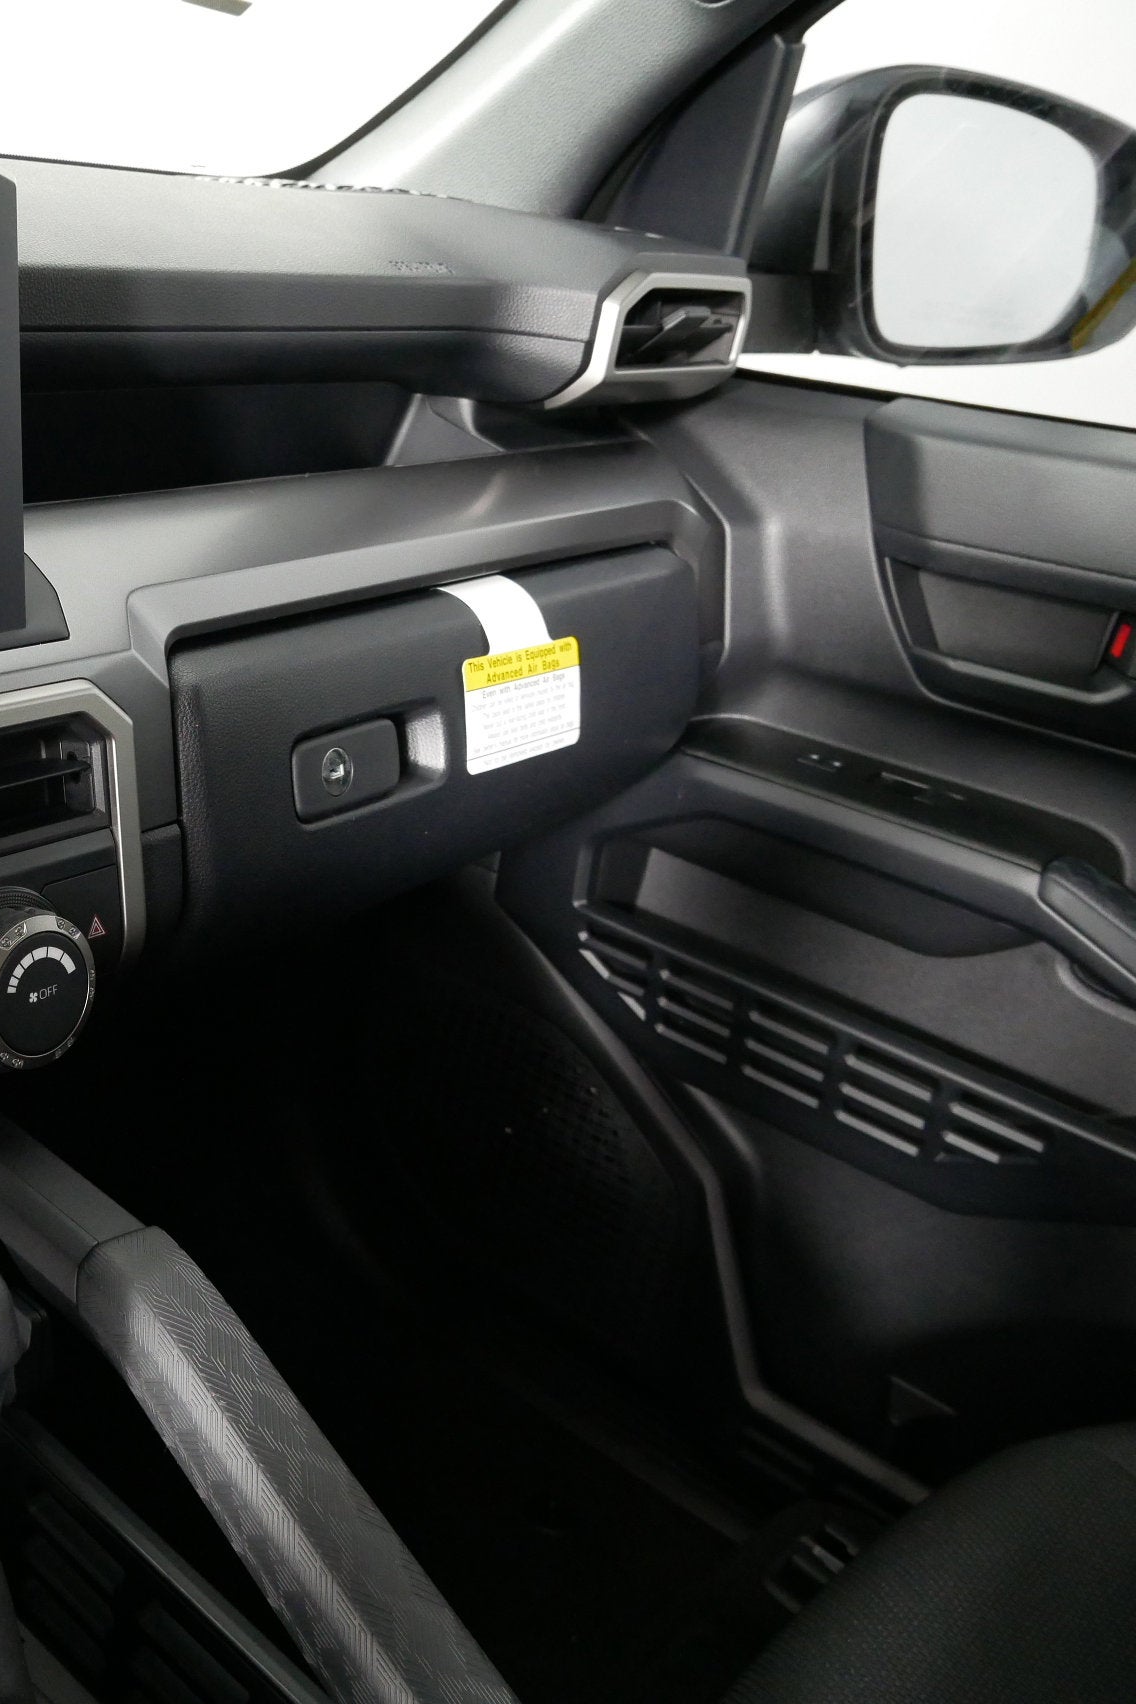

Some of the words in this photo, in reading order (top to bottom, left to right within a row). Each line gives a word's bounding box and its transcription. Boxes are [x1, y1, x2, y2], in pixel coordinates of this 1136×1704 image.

[468, 662, 484, 673] This
[487, 656, 513, 669] Vehicle
[516, 653, 522, 662] is
[525, 646, 557, 660] Equipped
[559, 642, 572, 653] with
[486, 668, 524, 684] Advanced
[527, 664, 538, 674] Air
[542, 659, 560, 671] Bags
[39, 984, 58, 1000] OFF
